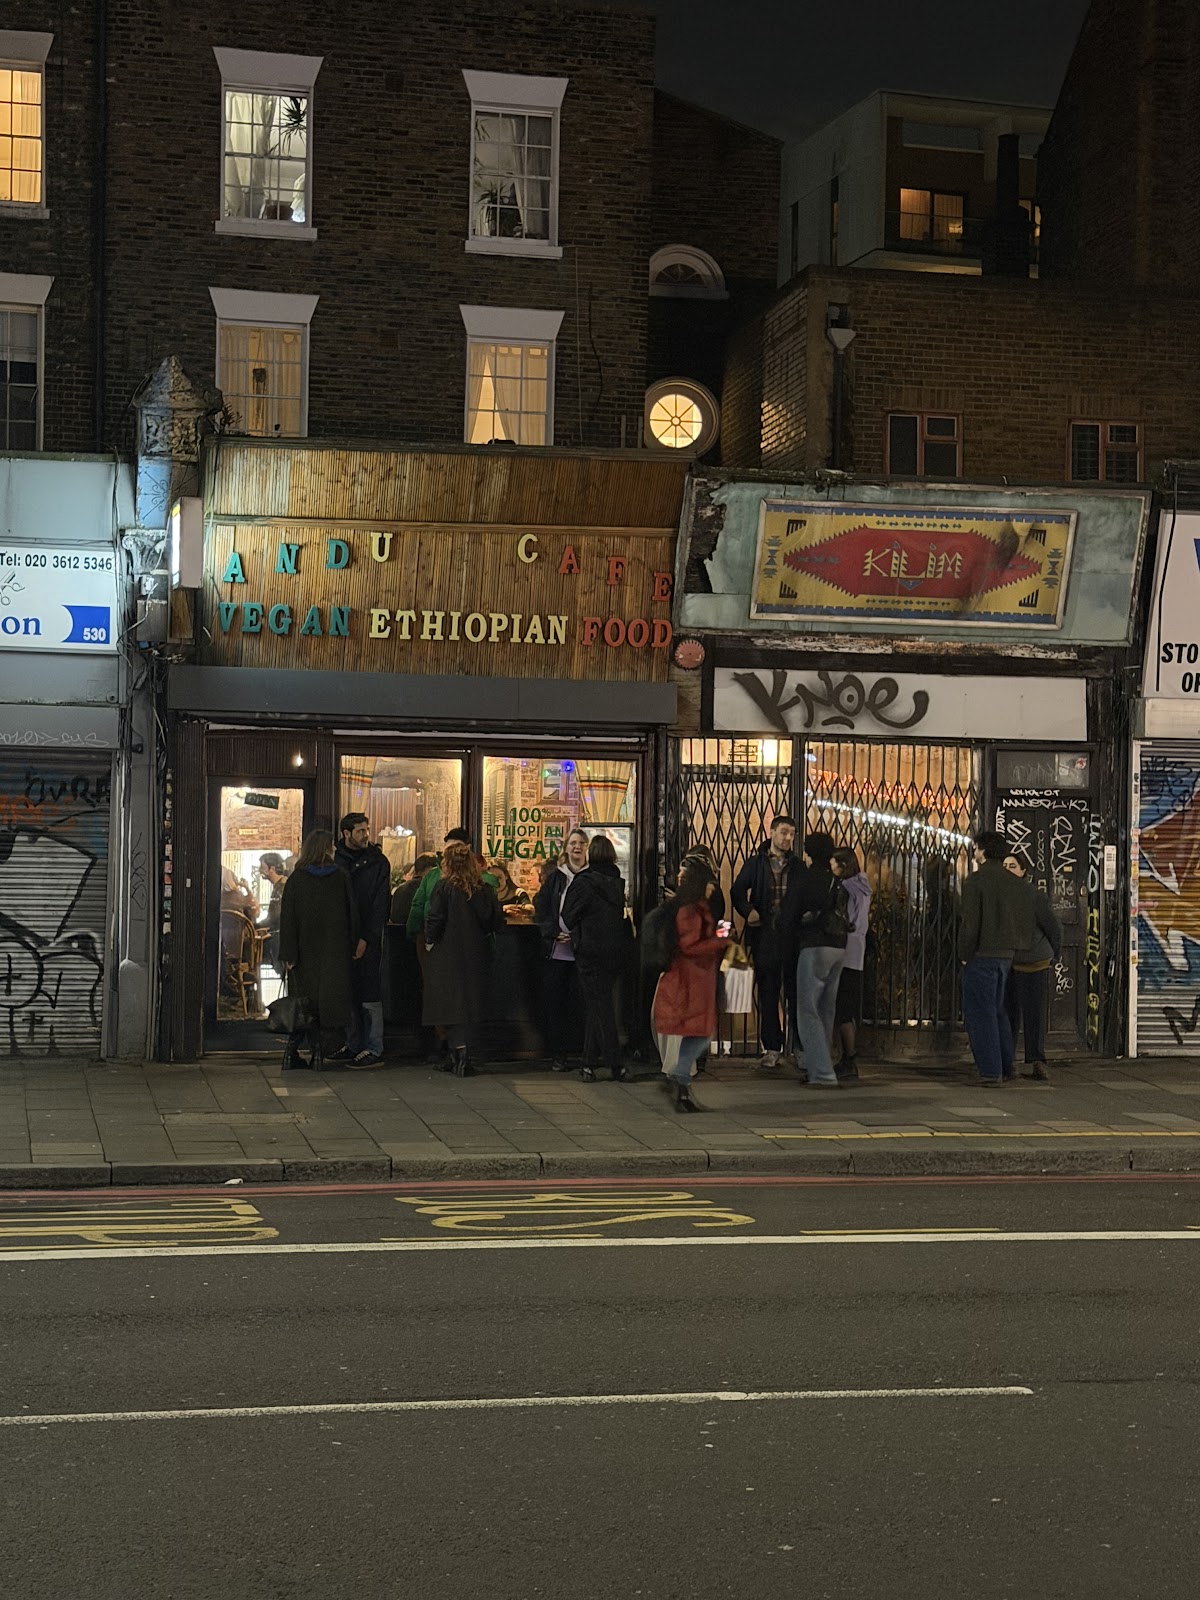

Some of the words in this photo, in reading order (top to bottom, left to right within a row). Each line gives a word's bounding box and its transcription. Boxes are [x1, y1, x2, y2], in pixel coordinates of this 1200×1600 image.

[0, 552, 20, 566] Tel:
[25, 554, 47, 568] 020
[52, 555, 80, 569] 3612
[83, 557, 113, 570] 5346
[517, 533, 673, 601] CAFE
[1, 616, 42, 636] on
[82, 627, 107, 641] 530
[218, 602, 351, 637] VEGAN
[369, 609, 568, 645] ETHIOPIAN
[581, 617, 674, 649] FOOD
[1161, 642, 1199, 664] STO
[510, 807, 552, 823] 100%
[486, 838, 563, 860] VEGAN
[394, 1191, 755, 1232] BUS
